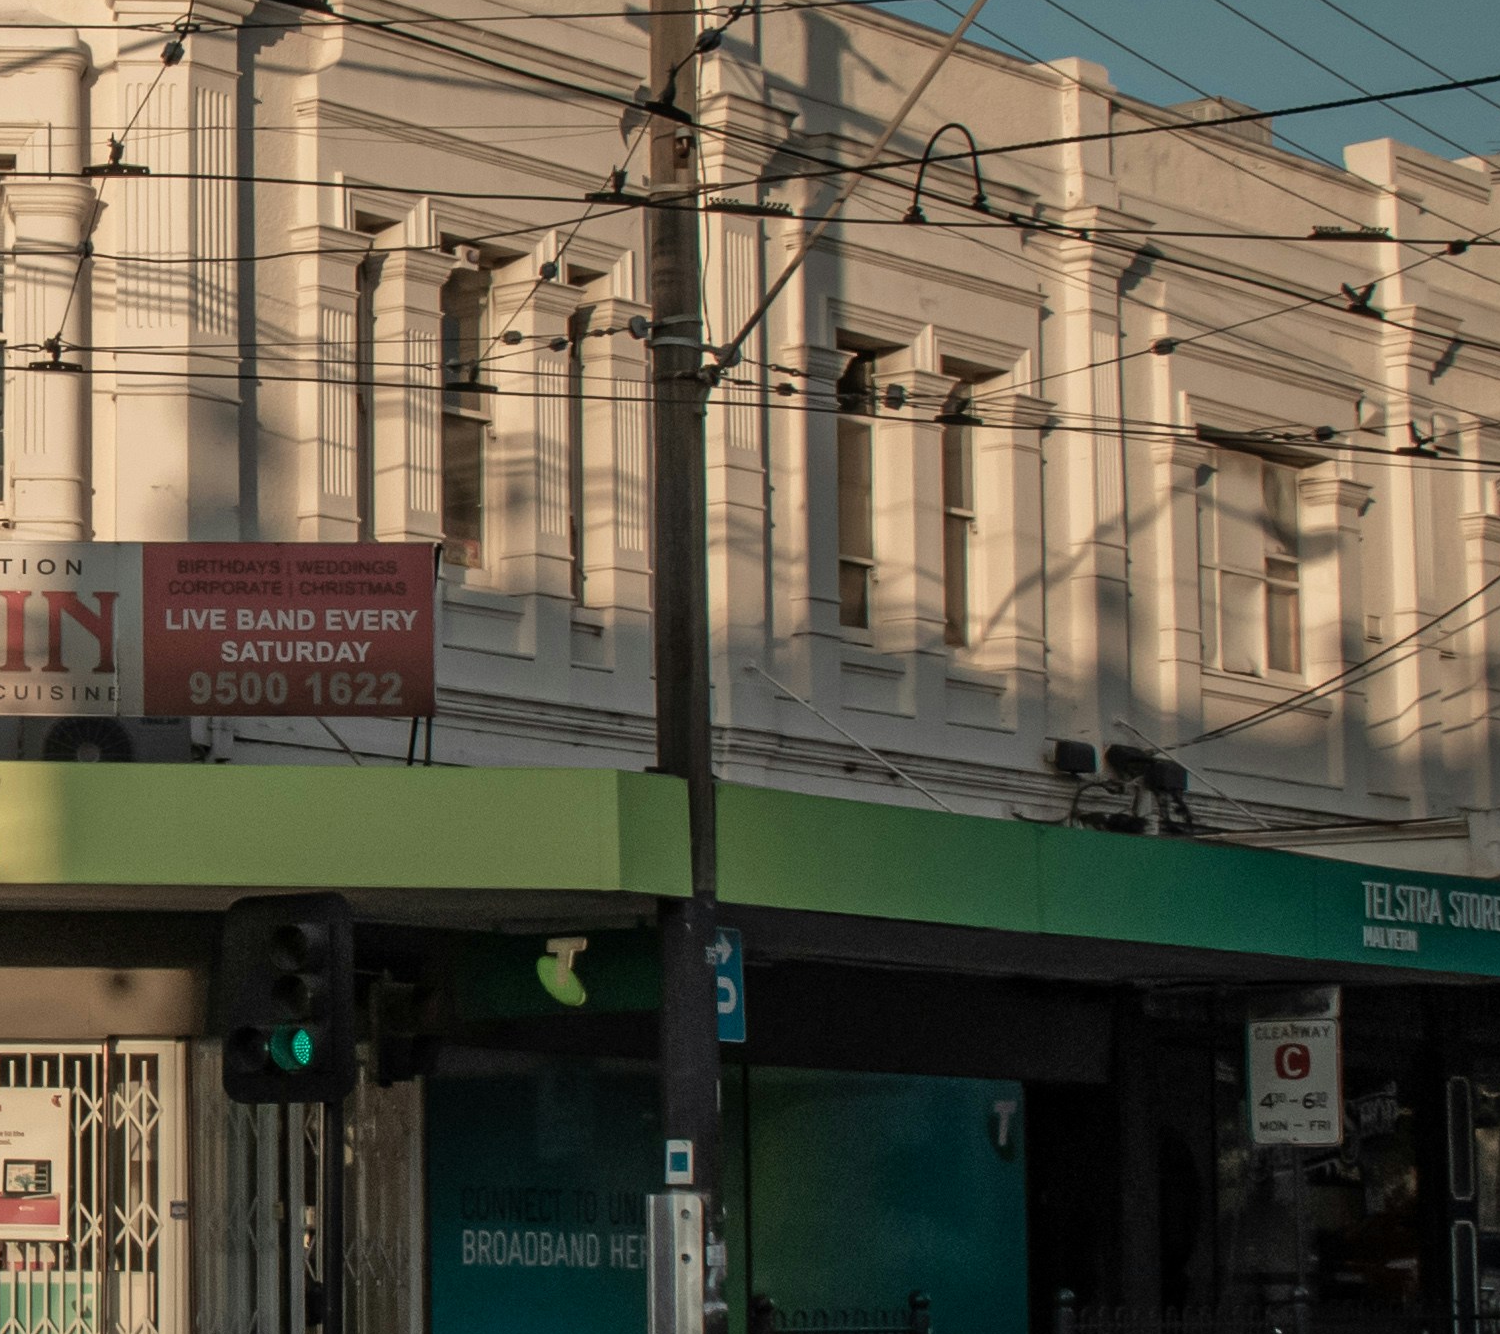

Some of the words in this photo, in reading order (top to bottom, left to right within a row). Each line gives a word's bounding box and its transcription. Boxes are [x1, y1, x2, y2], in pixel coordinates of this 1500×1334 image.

[178, 559, 281, 576] BIRTHDAYS
[296, 560, 398, 576] WEDDINGS
[169, 580, 283, 596] CORPORATE
[300, 581, 407, 597] CHRISTMAS
[165, 609, 228, 631] LIVE
[237, 610, 316, 631] BAND
[326, 610, 419, 631] EVERY
[221, 641, 372, 663] SATURDAY
[189, 671, 289, 706] 9500
[304, 672, 404, 706] 1622
[1361, 880, 1444, 926] TELSTRA
[1254, 1025, 1331, 1040] CLEARWAY
[1282, 1047, 1303, 1078] C
[1259, 1120, 1290, 1132] MON
[1309, 1119, 1332, 1132] FRI
[462, 1229, 601, 1267] BROADBAND
